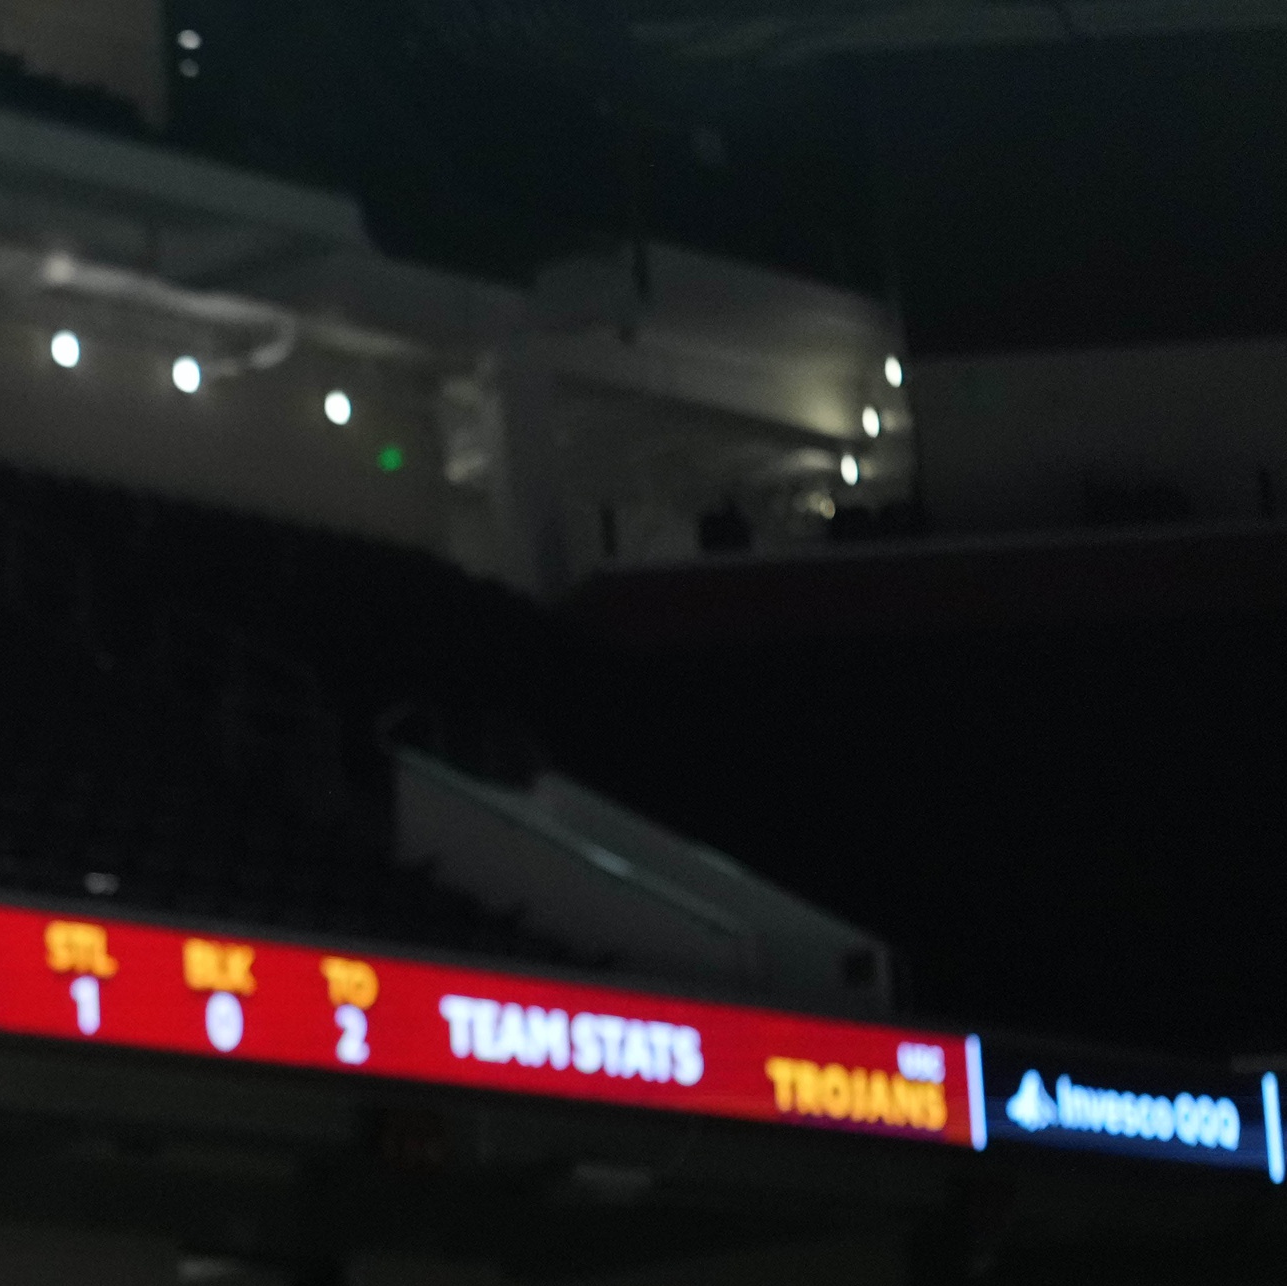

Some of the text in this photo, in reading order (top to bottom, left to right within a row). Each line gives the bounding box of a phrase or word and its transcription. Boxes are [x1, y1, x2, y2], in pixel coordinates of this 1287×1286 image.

[70, 975, 102, 1036] 1
[205, 991, 244, 1053] 0
[334, 1003, 370, 1065] 2
[320, 954, 379, 1011] TO
[439, 993, 704, 1087] TEAM STATS
[765, 1055, 948, 1132] TROJANS
